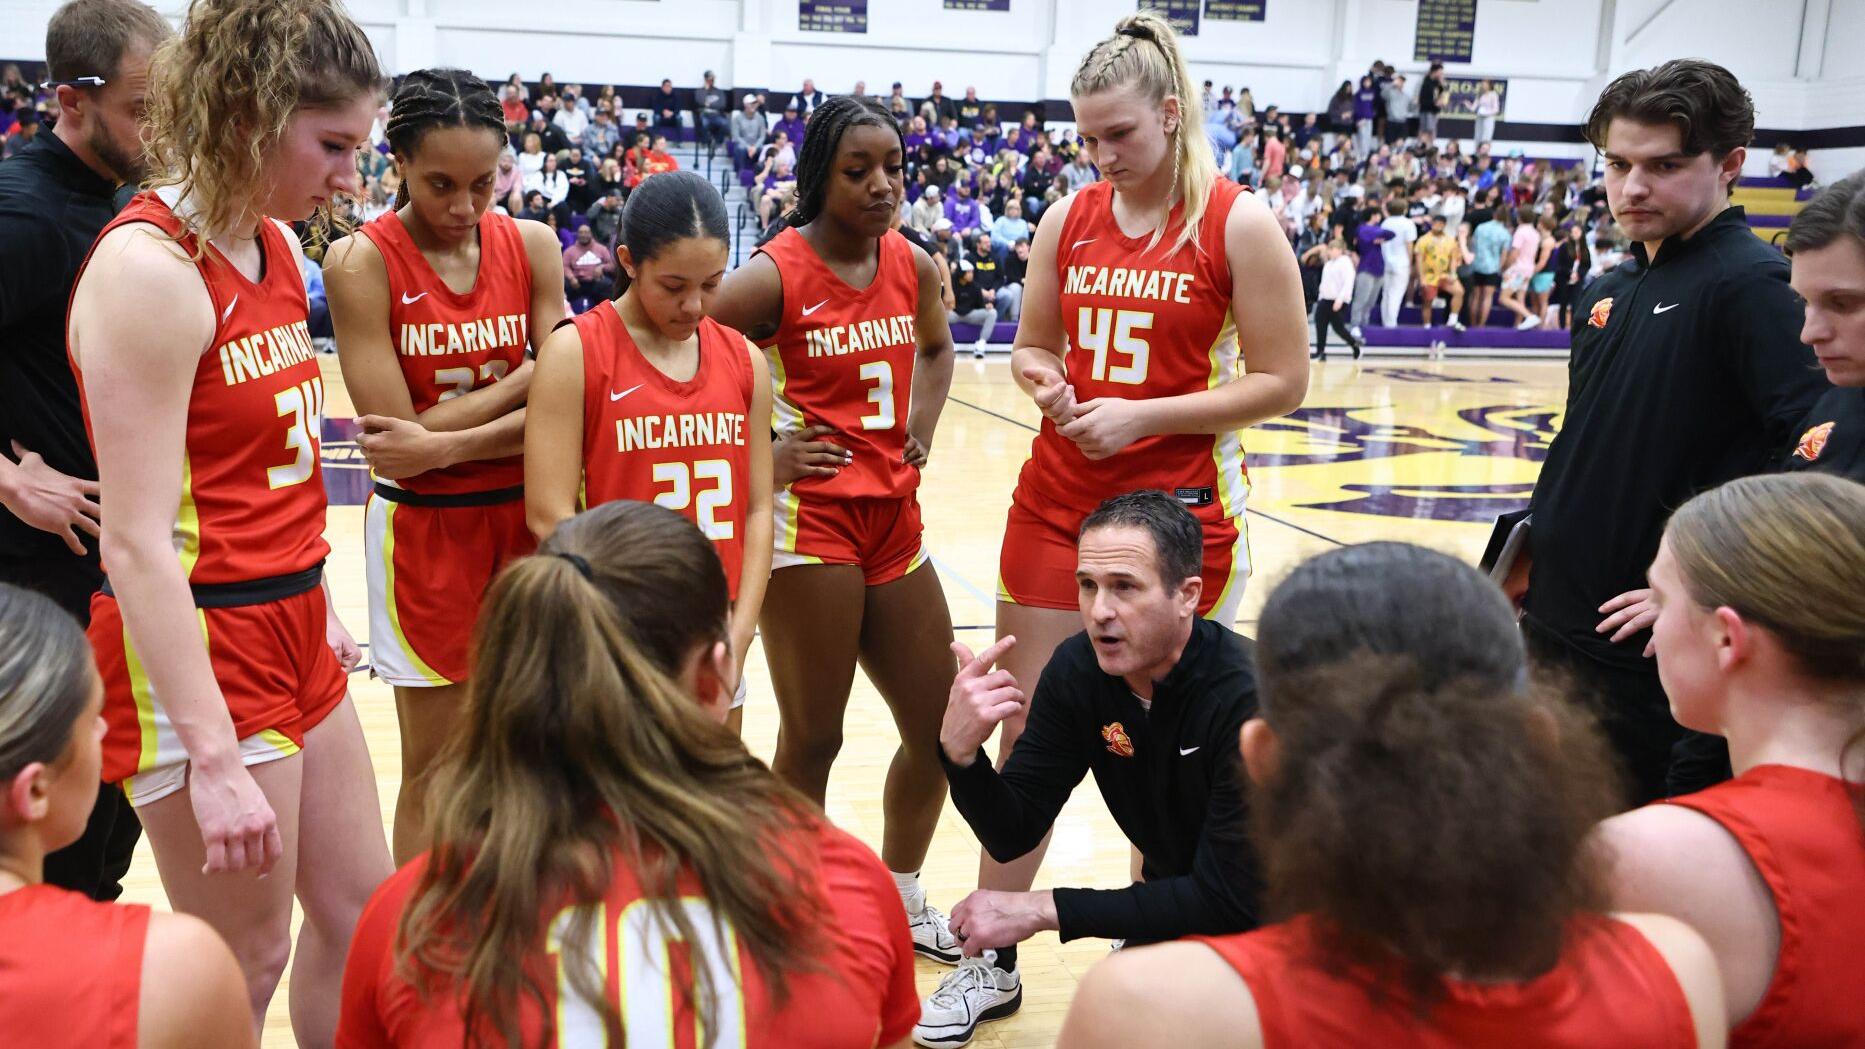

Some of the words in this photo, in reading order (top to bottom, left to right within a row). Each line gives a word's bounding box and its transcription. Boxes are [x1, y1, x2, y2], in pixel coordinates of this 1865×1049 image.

[219, 319, 316, 386] INCARNAT
[1078, 306, 1155, 385] 45
[859, 360, 896, 430] 3
[266, 376, 322, 490] 34
[615, 412, 745, 453] INCARNATE
[652, 458, 734, 541] 22
[1204, 492, 1209, 500] L
